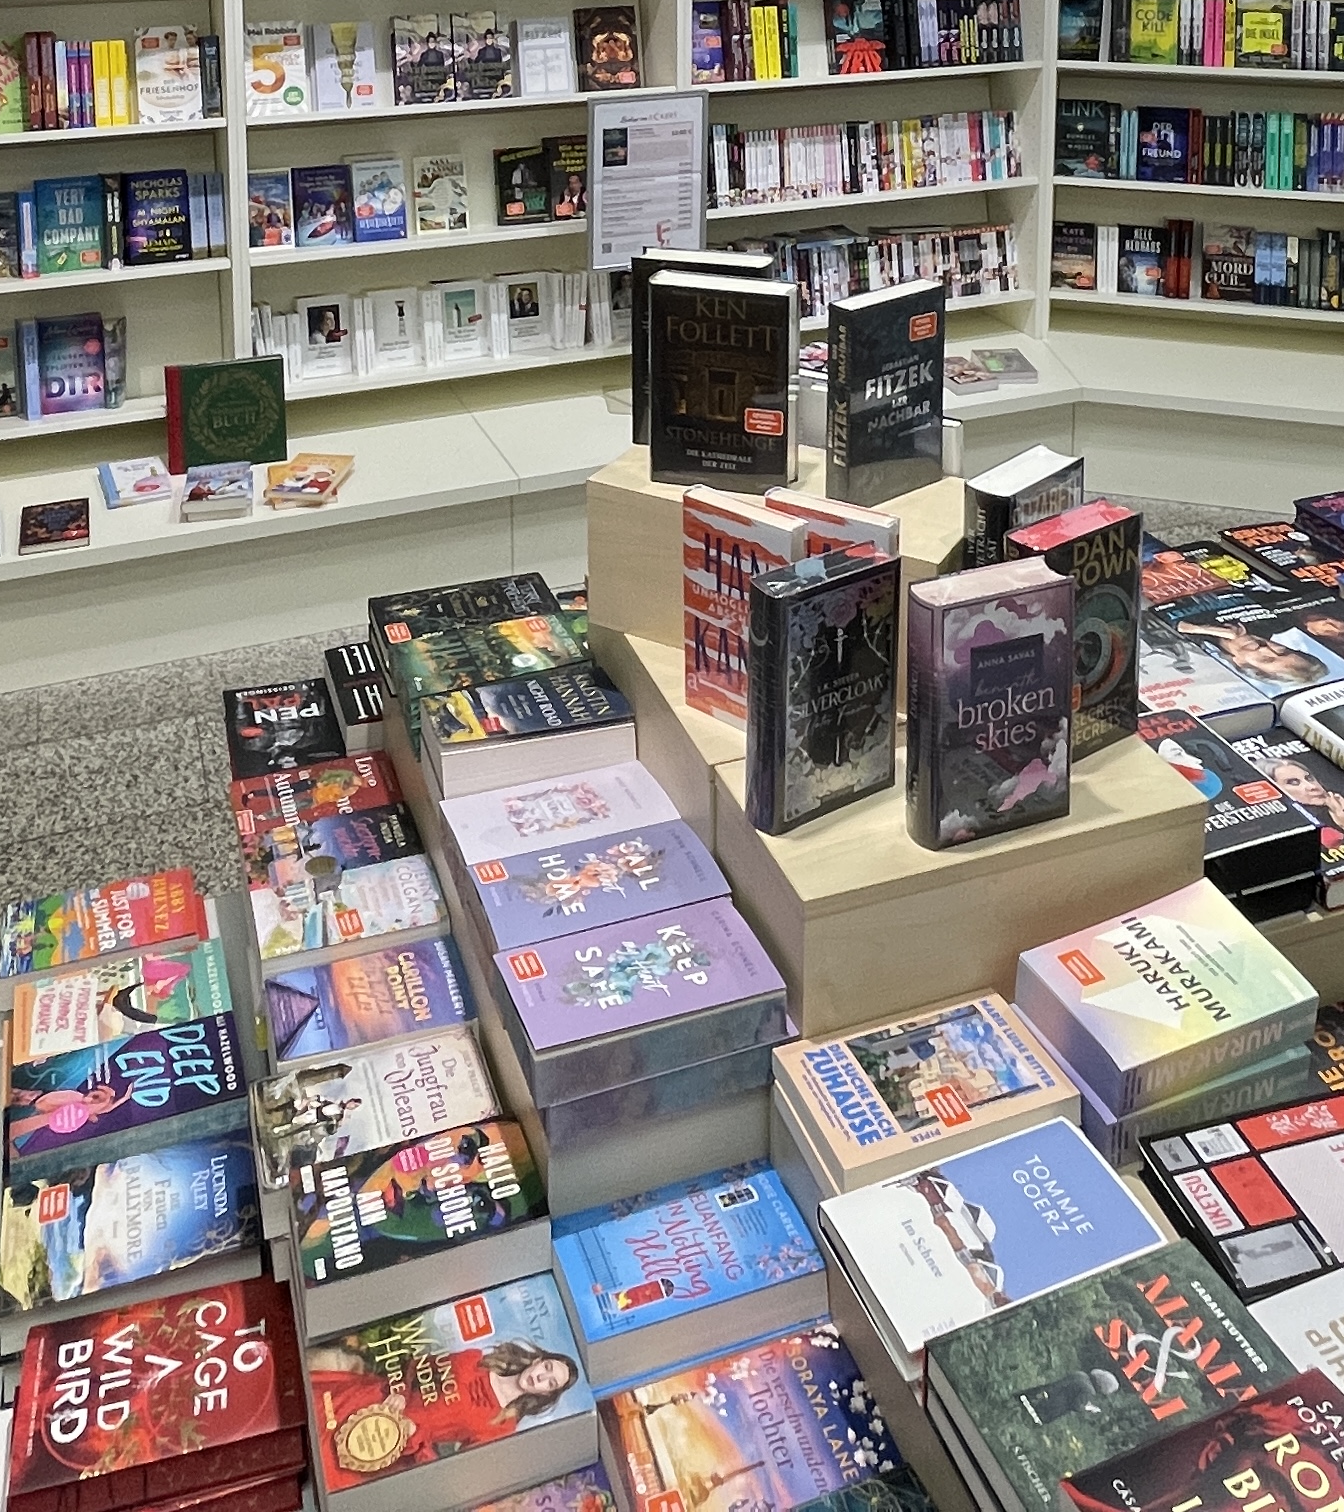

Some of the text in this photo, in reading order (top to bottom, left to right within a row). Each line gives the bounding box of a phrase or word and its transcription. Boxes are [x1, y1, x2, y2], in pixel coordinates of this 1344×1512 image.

[1135, 8, 1173, 23] CODE
[1141, 20, 1166, 33] KILL
[1060, 102, 1105, 118] LINK
[130, 175, 183, 189] NICHOLAS
[1142, 147, 1182, 160] FREUND
[56, 189, 85, 205] VERY
[59, 208, 83, 224] BAD
[134, 187, 181, 200] SPARKS
[43, 225, 100, 244] COMPANY
[1210, 260, 1254, 275] MORD
[665, 318, 780, 351] FOLLETT
[694, 297, 747, 320] KEN
[864, 359, 933, 401] FITZEK
[212, 412, 256, 431] BUCH
[665, 426, 777, 453] STONEHENGE
[833, 400, 848, 468] FITZEK
[867, 400, 931, 434] NACHBAR
[1073, 529, 1124, 566] DAN
[977, 649, 1035, 669] ANNA SAVAS
[255, 702, 319, 724] PEN
[791, 675, 885, 724] SILVERCLOAK
[957, 685, 1055, 730] broken
[975, 719, 1038, 754] skies
[272, 771, 302, 828] Autumn
[539, 853, 587, 917] HOME
[94, 898, 117, 952] SUMMER
[109, 889, 137, 940] JUST FOR
[575, 945, 624, 1010] SAFE
[658, 924, 709, 986] KEEP
[1115, 942, 1188, 1012] HARUKI
[1122, 915, 1232, 1023] MURAKAMI
[385, 965, 407, 1011] POINT
[398, 952, 431, 1021] CARILLON
[161, 1024, 221, 1096] DEEP
[218, 1033, 238, 1092] HAZELWOOD
[980, 999, 1056, 1088] MARIE LUISE RITTER
[115, 1052, 170, 1106] END
[413, 1044, 447, 1123] Jungfrau
[804, 1048, 881, 1147] ZUHAUSE
[826, 1043, 896, 1140] DIE SUCHE NACH
[192, 1169, 209, 1212] RILEY
[208, 1153, 229, 1222] LUCINDA
[433, 1162, 477, 1238] SCHÖNE
[478, 1143, 521, 1201] HALLO
[1027, 1154, 1094, 1236] TOMMIE
[125, 1160, 143, 1264] BALLYMORE
[153, 1178, 168, 1231] Frauen
[320, 1166, 363, 1267] NAPOLITANO
[357, 1189, 387, 1228] ANN
[1013, 1169, 1064, 1237] GOERZ
[1180, 1174, 1233, 1231] UKETSU
[688, 1185, 746, 1282] NEUANFANG
[901, 1218, 944, 1278] Im Schnee
[231, 1318, 268, 1373] TO
[1137, 1273, 1256, 1402] MAMA
[1191, 1279, 1270, 1374] SARAH KUTTNER
[97, 1324, 140, 1432] WILD
[142, 1353, 185, 1389] A
[192, 1300, 230, 1416] CAGE
[368, 1338, 406, 1395] HURE
[391, 1316, 439, 1406] WANDER
[760, 1351, 777, 1376] Die
[1093, 1318, 1189, 1422] SAM
[49, 1340, 87, 1443] BIRD
[784, 1341, 860, 1481] SORAYA LANE
[745, 1381, 795, 1472] Tochter
